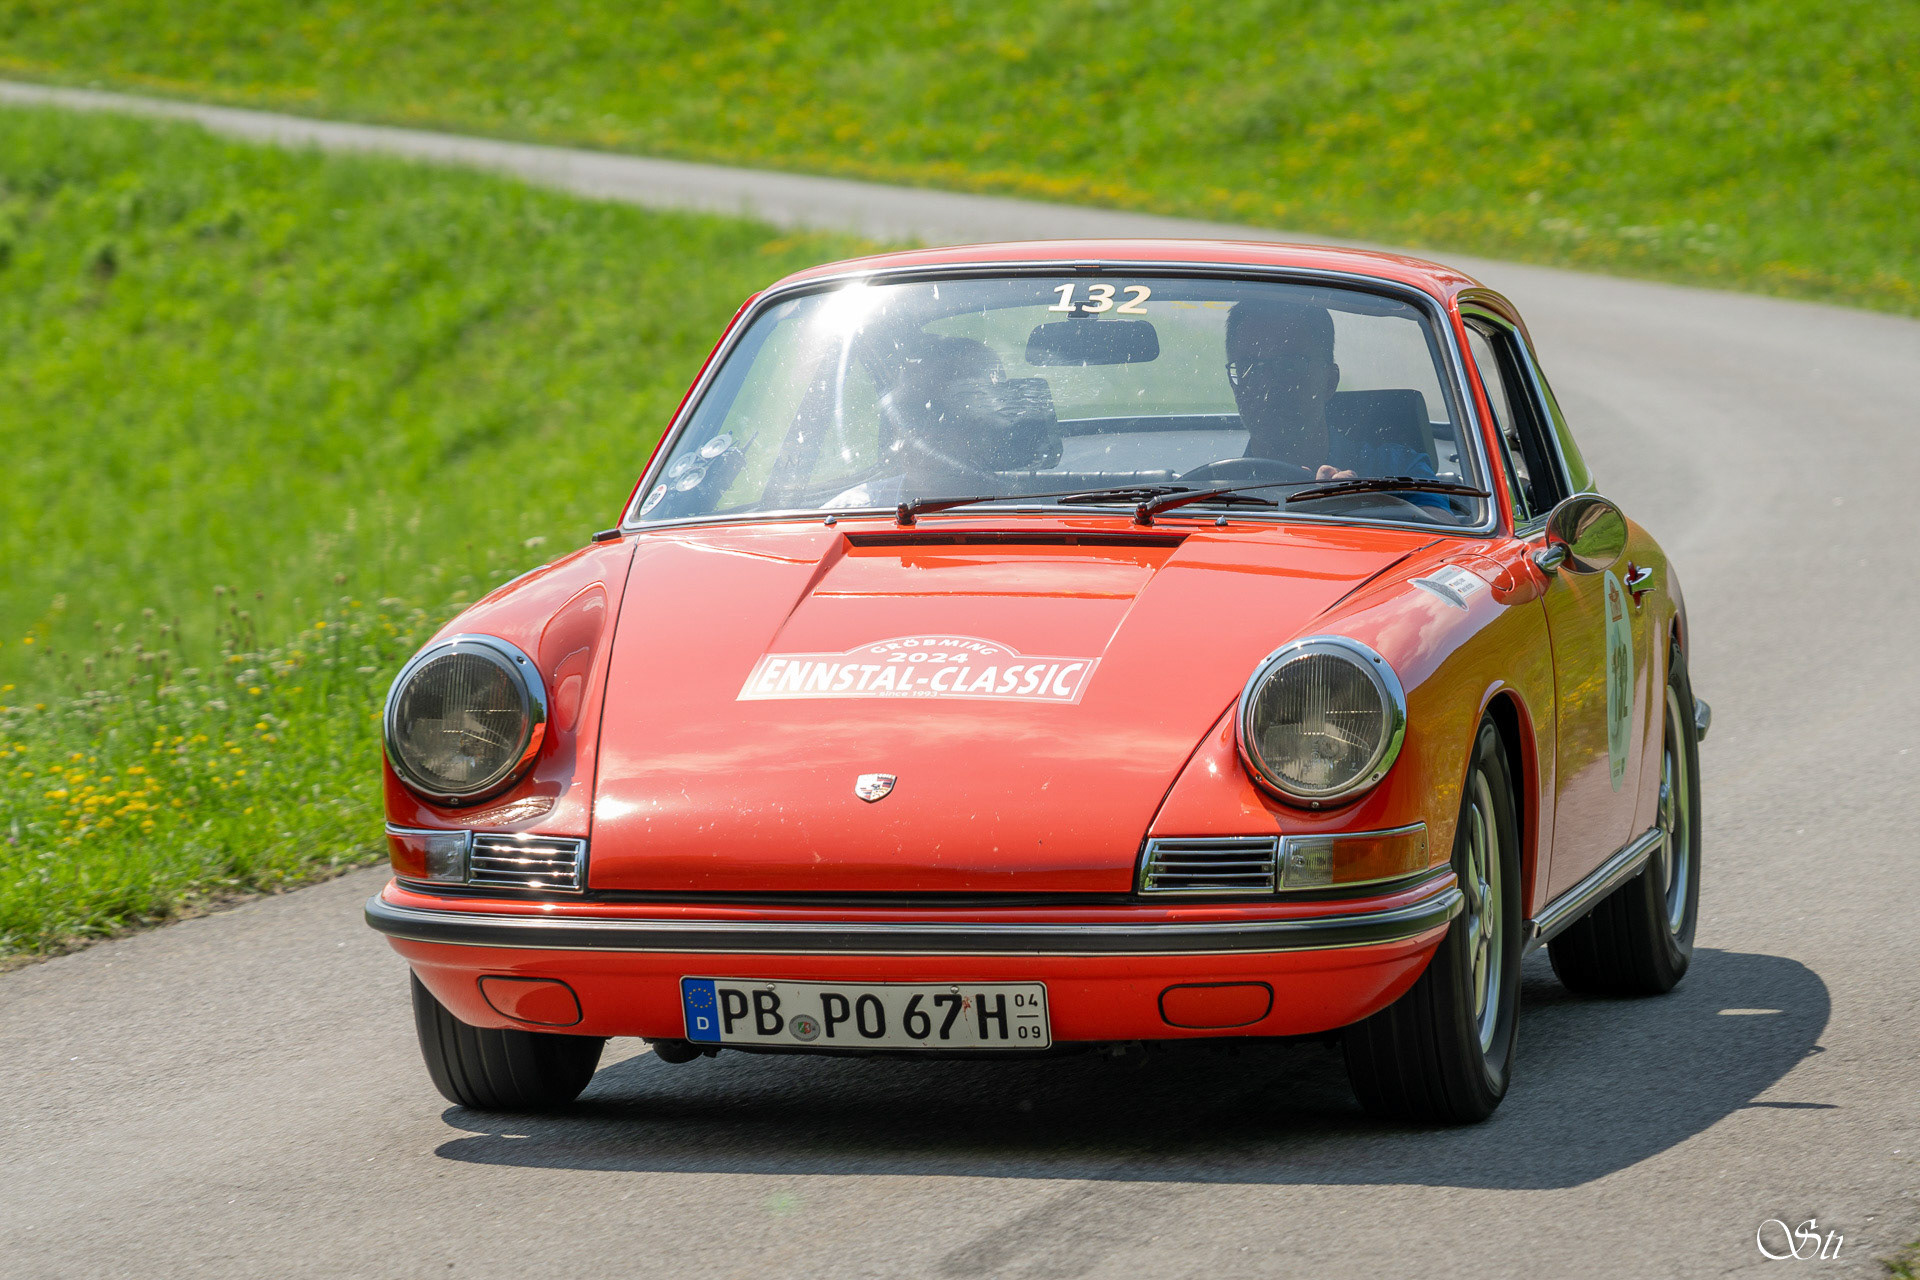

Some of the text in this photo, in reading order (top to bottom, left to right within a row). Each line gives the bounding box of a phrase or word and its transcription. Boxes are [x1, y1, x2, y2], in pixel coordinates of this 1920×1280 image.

[1048, 283, 1151, 315] 132
[870, 638, 998, 655] GRÖBMING
[886, 652, 969, 663] 2024
[756, 658, 1084, 696] ENNSTAL-CLASSIC
[1014, 993, 1038, 1007] 04
[718, 988, 784, 1036] PB
[820, 992, 886, 1039] PO
[697, 1016, 710, 1031] D
[1017, 1025, 1041, 1039] 09
